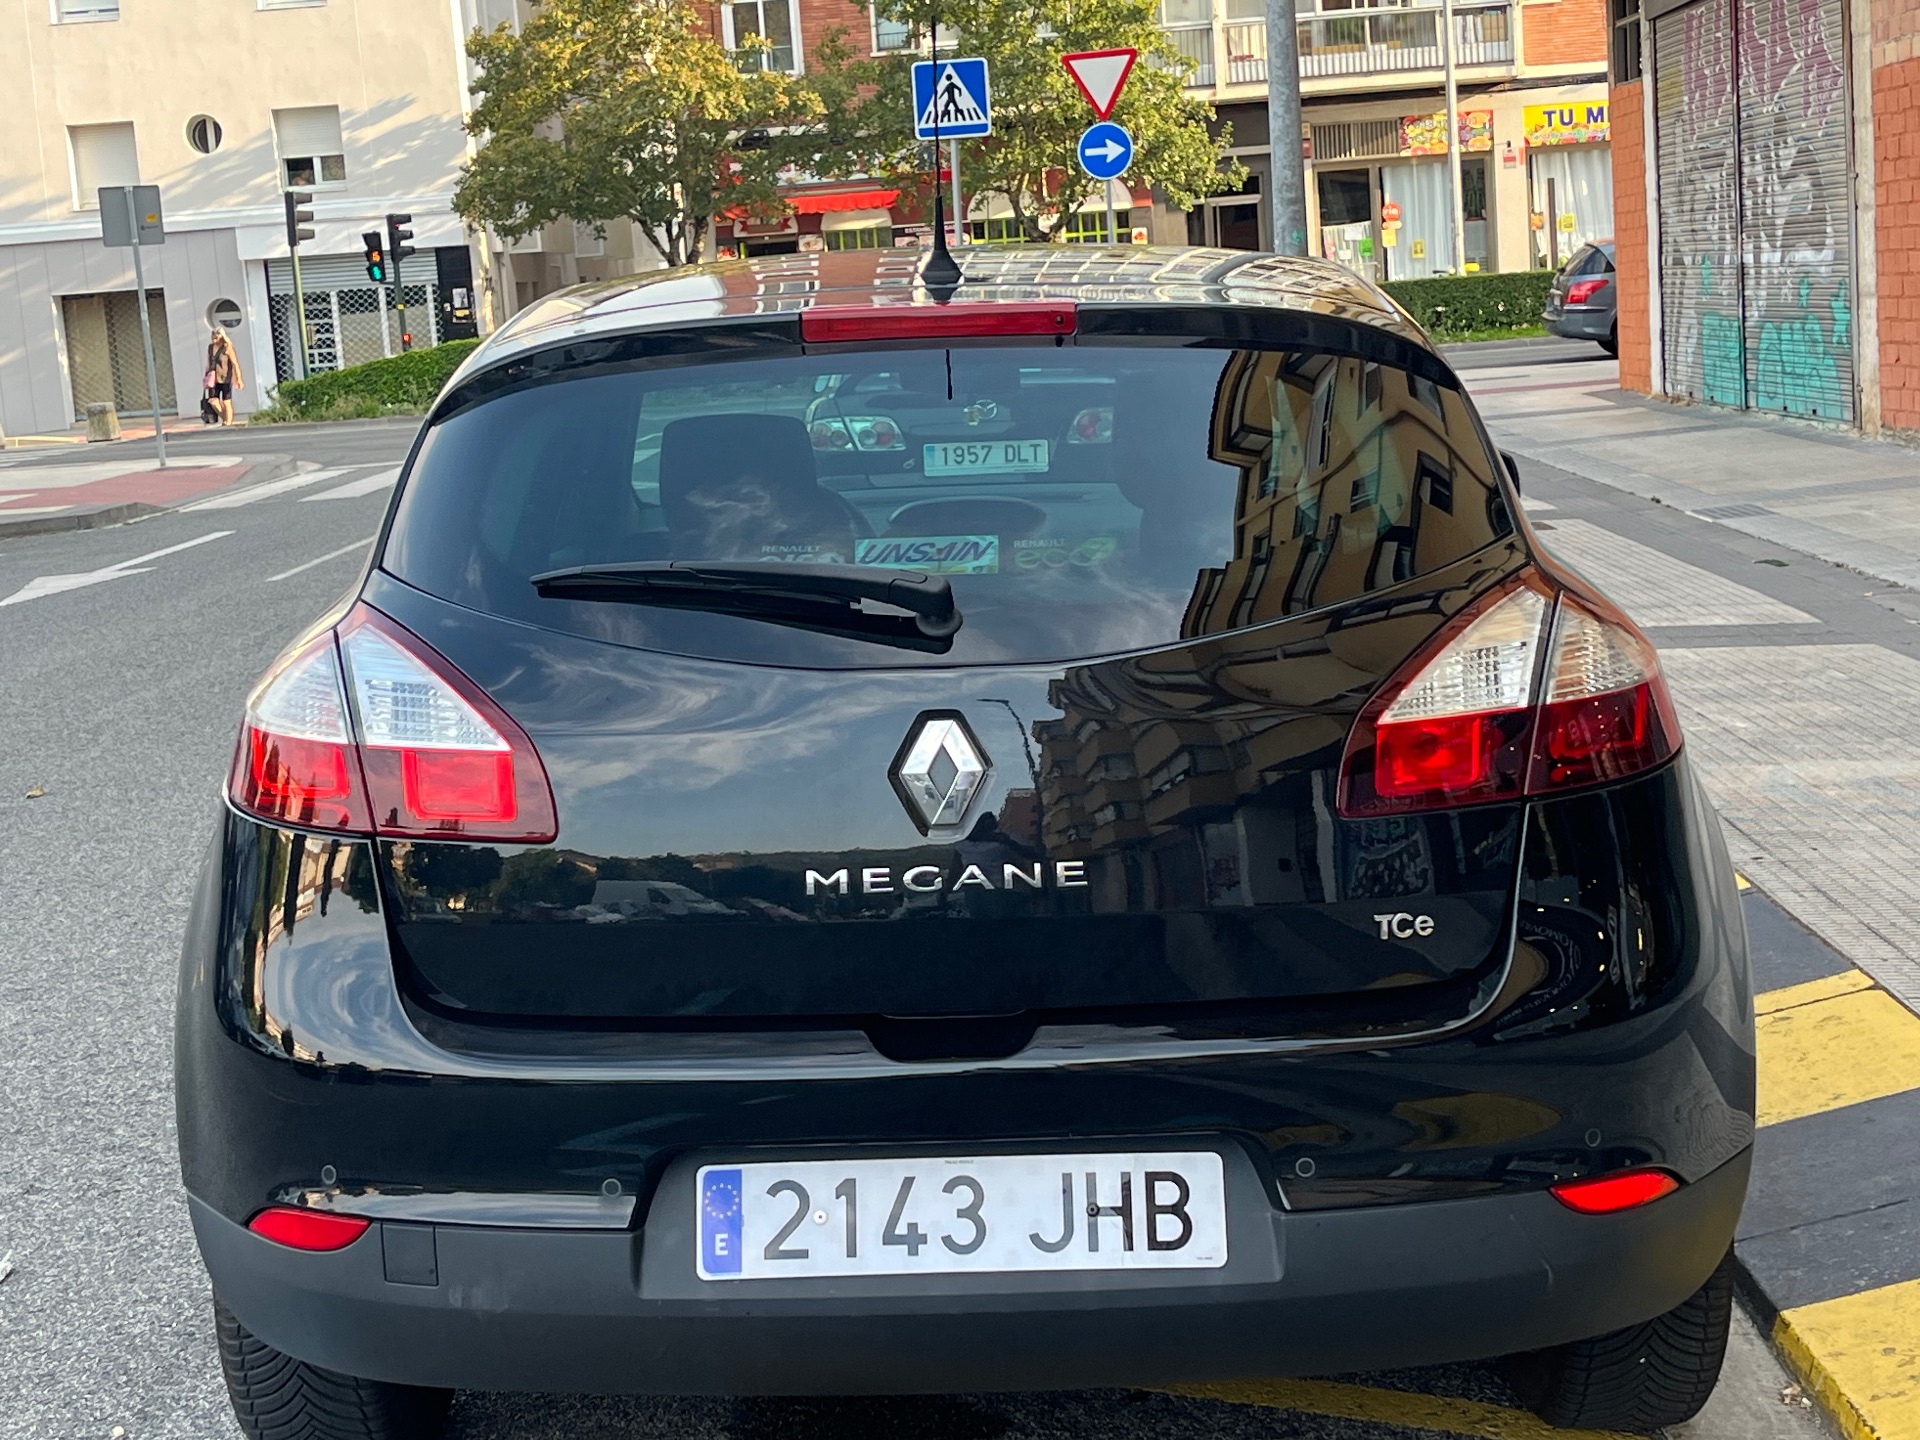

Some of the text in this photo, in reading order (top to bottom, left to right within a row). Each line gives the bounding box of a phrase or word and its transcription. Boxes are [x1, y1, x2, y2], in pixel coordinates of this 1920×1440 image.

[1542, 105, 1609, 127] TU M
[941, 443, 1042, 466] 1957 DLT
[761, 544, 822, 553] RENAULT
[1013, 539, 1065, 548] RENAULT
[805, 861, 1089, 896] MEGANE
[1373, 912, 1435, 940] TCe
[763, 1171, 1194, 1261] 2143 JHB
[714, 1233, 728, 1256] E
